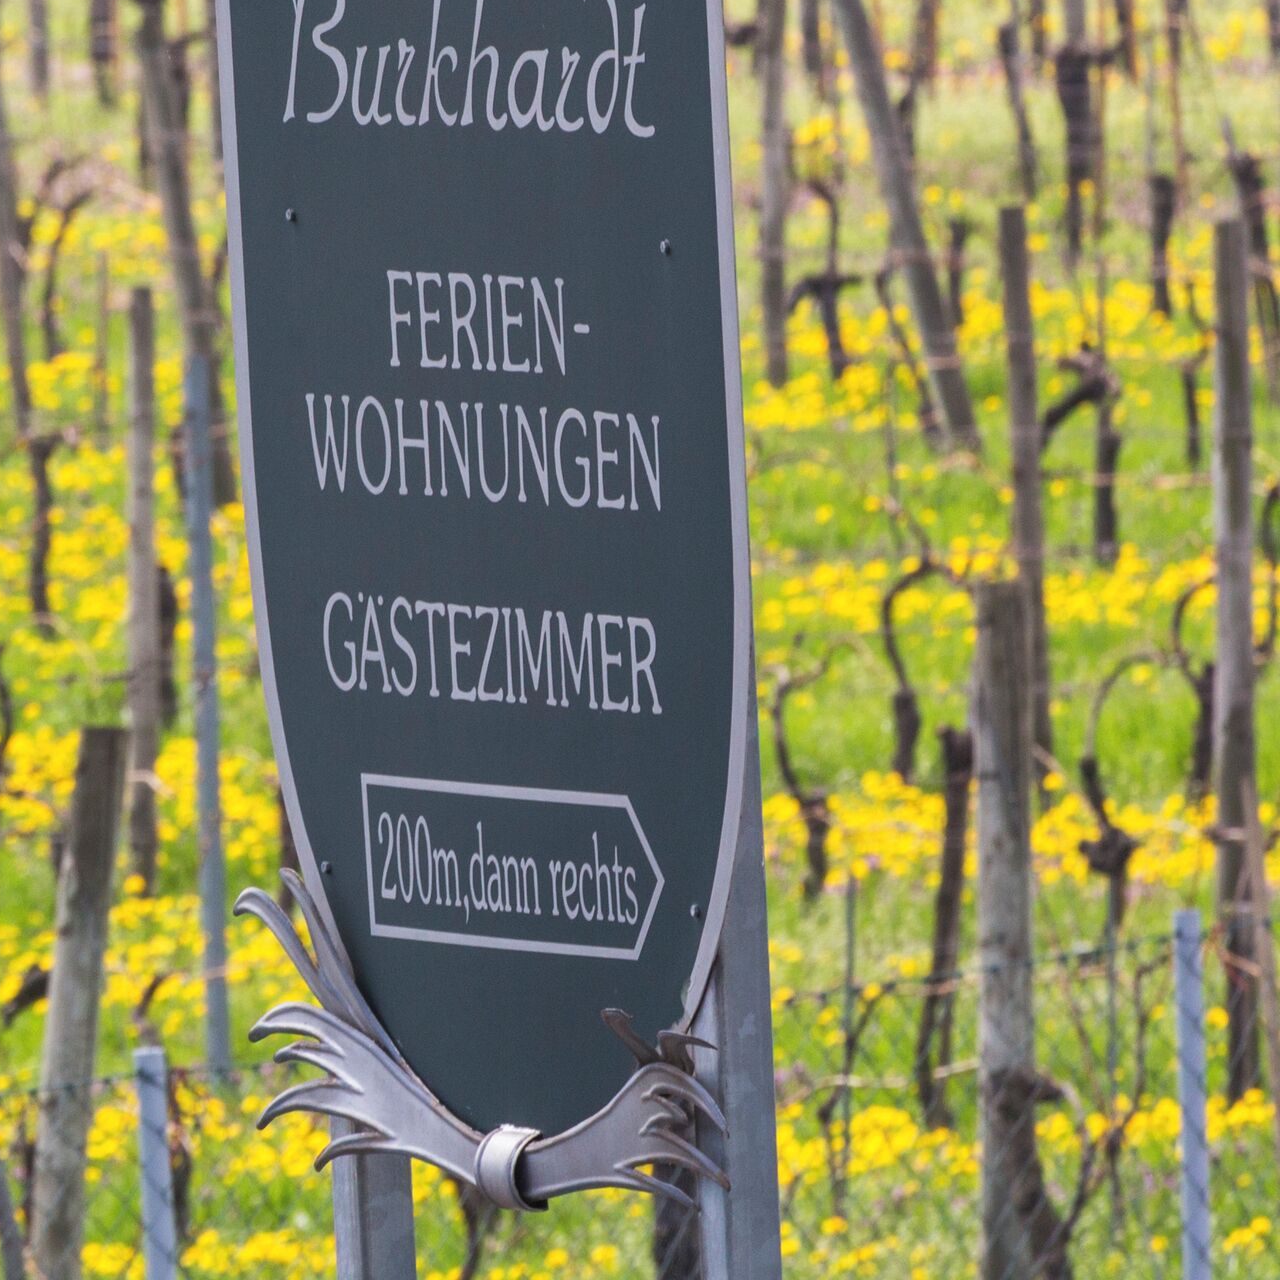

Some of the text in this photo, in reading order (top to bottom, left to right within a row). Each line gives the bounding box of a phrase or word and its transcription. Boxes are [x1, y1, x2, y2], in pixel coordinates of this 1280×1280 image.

[386, 269, 590, 376] FERIEN-
[305, 392, 662, 511] WOHNUNGEN
[322, 591, 662, 715] GÄSTEZIMMER
[377, 811, 639, 925] 200m,dann rechts
